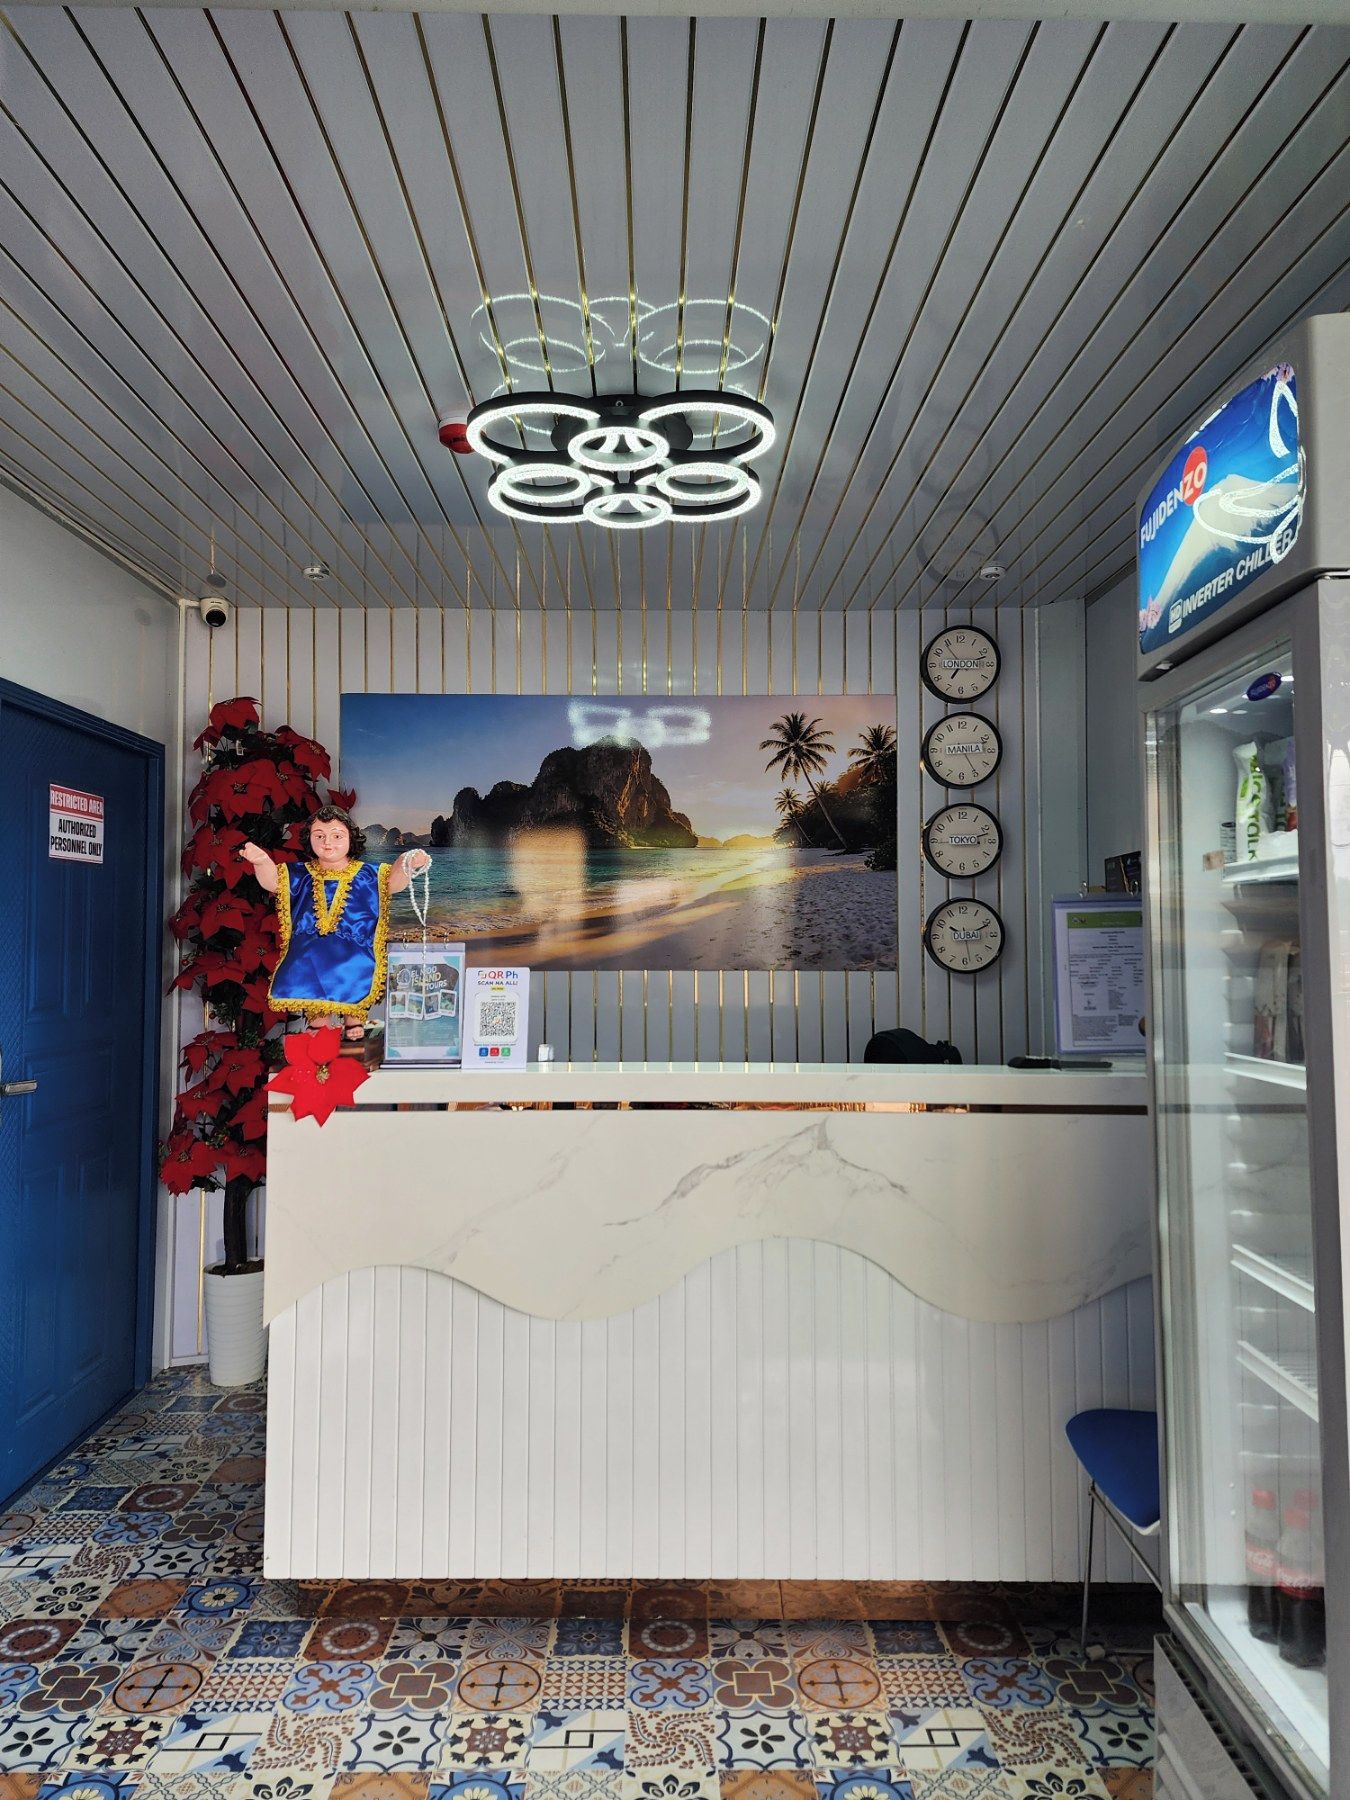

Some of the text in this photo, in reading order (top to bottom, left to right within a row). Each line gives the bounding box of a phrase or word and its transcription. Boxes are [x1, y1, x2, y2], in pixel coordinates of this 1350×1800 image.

[1140, 461, 1207, 549] FUJIDENZO
[1182, 567, 1235, 618] INVERTER
[956, 635, 966, 643] 12
[933, 647, 943, 657] 10
[979, 647, 988, 656] 2
[943, 660, 979, 668] LONDON
[933, 674, 942, 682] 8
[945, 683, 952, 691] 7
[957, 686, 964, 694] 6
[970, 682, 978, 691] 5
[957, 720, 967, 729] 12
[934, 733, 945, 742] 10
[947, 744, 981, 753] MANILA
[934, 760, 943, 768] 8
[946, 769, 953, 777] 7
[958, 771, 965, 780] 6
[972, 769, 979, 777] 5
[50, 790, 104, 816] RESTRICTED AREA
[958, 811, 968, 819] 12
[58, 818, 97, 838] AUTHORIZED
[935, 823, 945, 833] 10
[981, 824, 990, 833] 2
[949, 836, 977, 844] TOKYO
[50, 835, 102, 856] PERSONNEL ONLY
[934, 850, 943, 858] 8
[959, 862, 966, 870] 6
[972, 859, 980, 868] 5
[958, 905, 968, 914] 12
[936, 918, 946, 929] 10
[953, 931, 979, 940] DUBAI
[937, 946, 946, 954] 8
[949, 954, 956, 962] 7
[962, 957, 968, 965] 6
[975, 953, 983, 962] 5
[488, 970, 519, 980] QR Ph
[425, 979, 447, 990] TOURS
